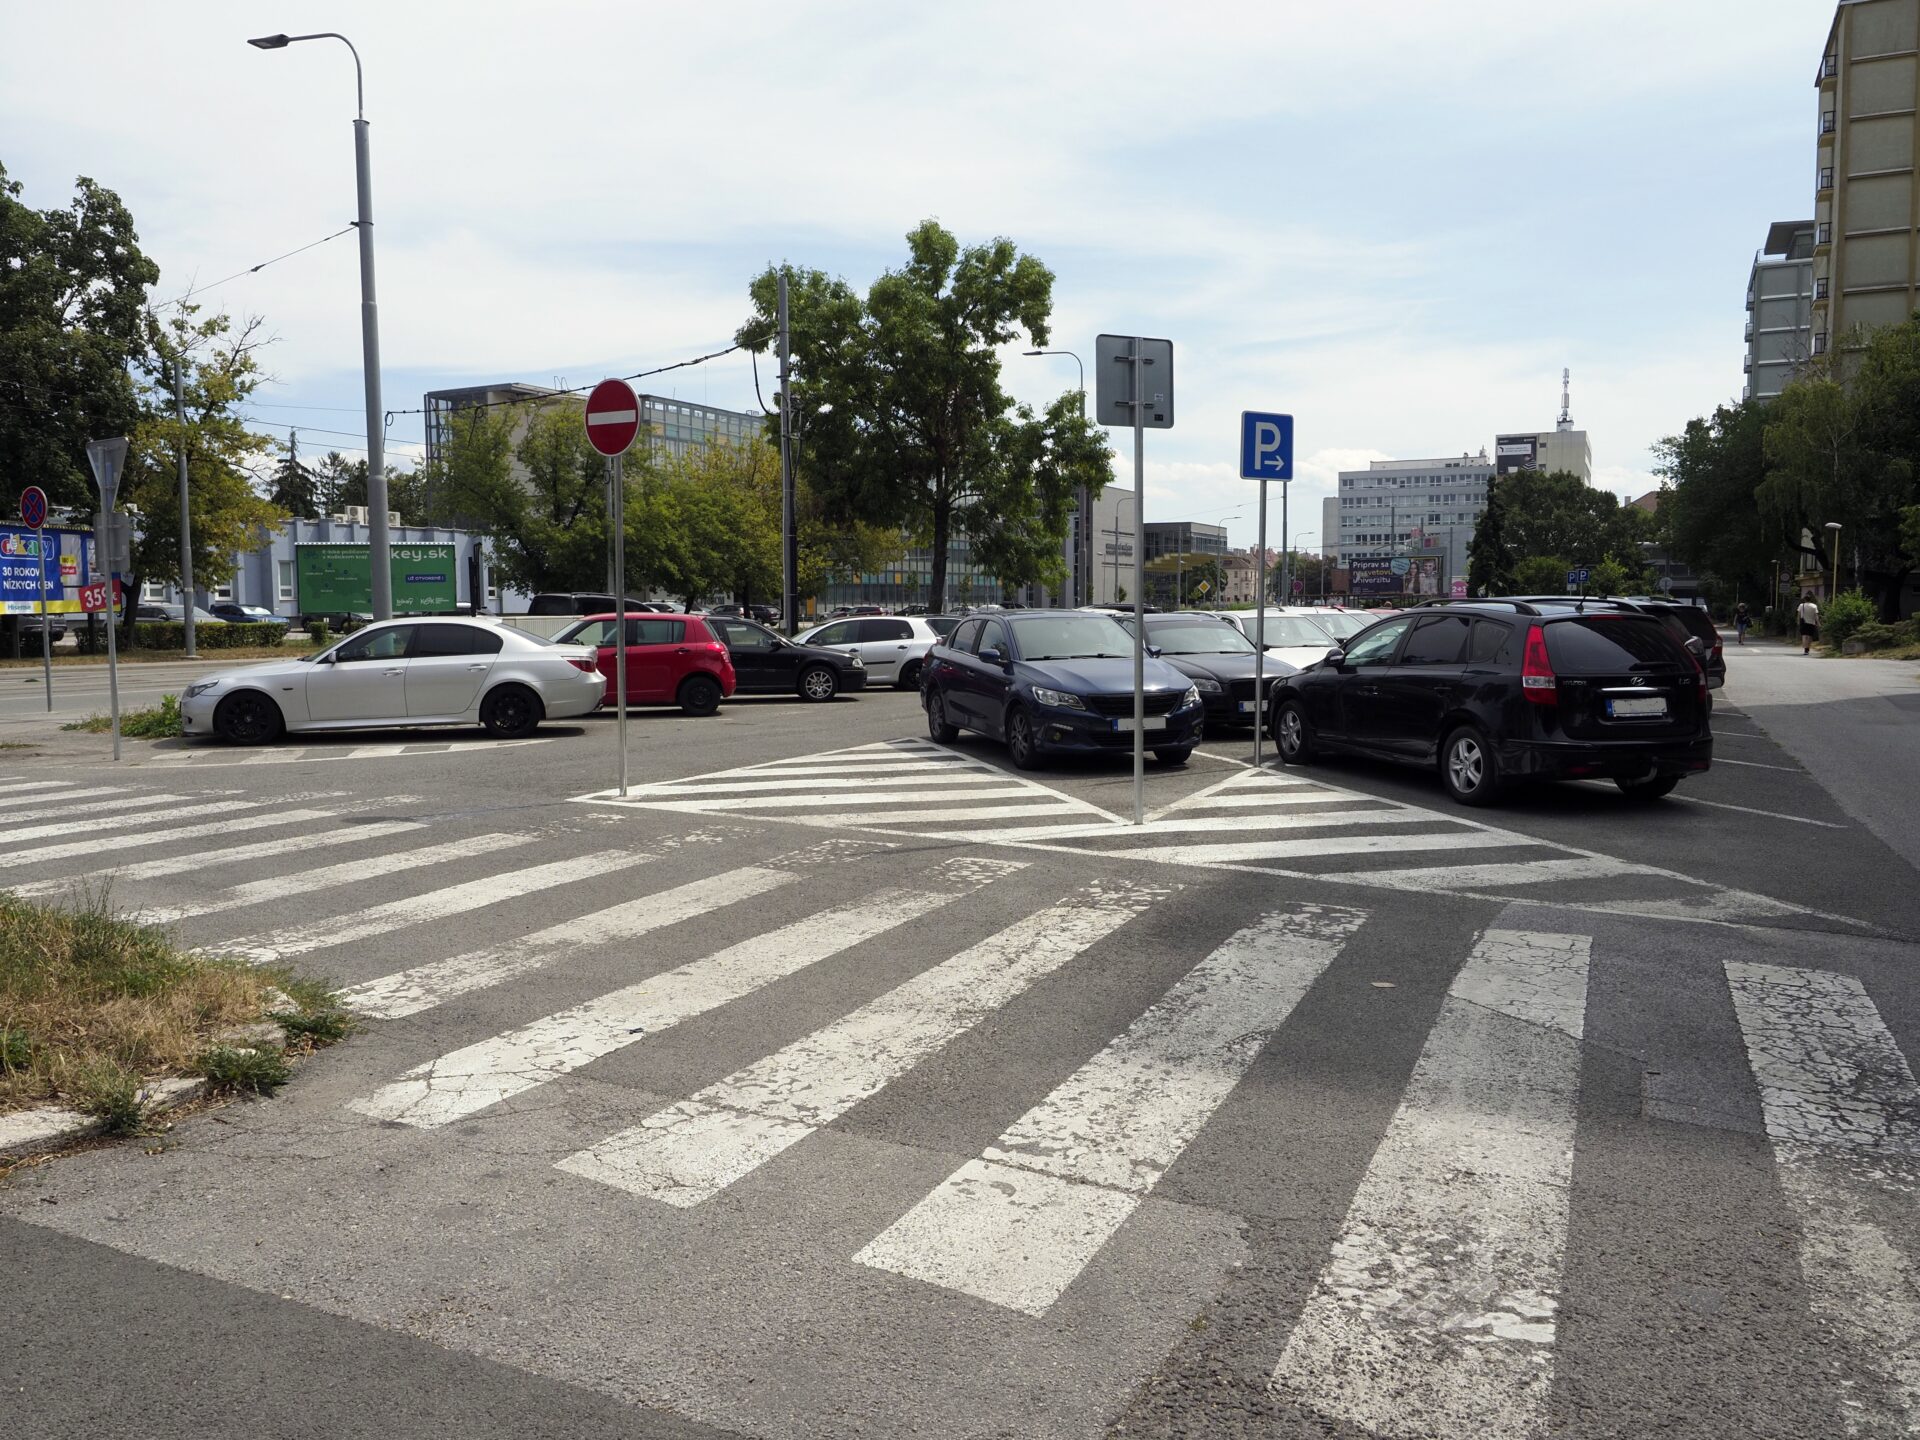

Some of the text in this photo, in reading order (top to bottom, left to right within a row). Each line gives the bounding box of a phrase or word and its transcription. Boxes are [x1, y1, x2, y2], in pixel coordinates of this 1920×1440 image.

[1254, 421, 1281, 470] P
[391, 547, 448, 562] key.sk
[1352, 561, 1380, 570] Priprav
[2, 566, 40, 577] 30 ROKOV
[3, 579, 36, 590] NÍZKYCH
